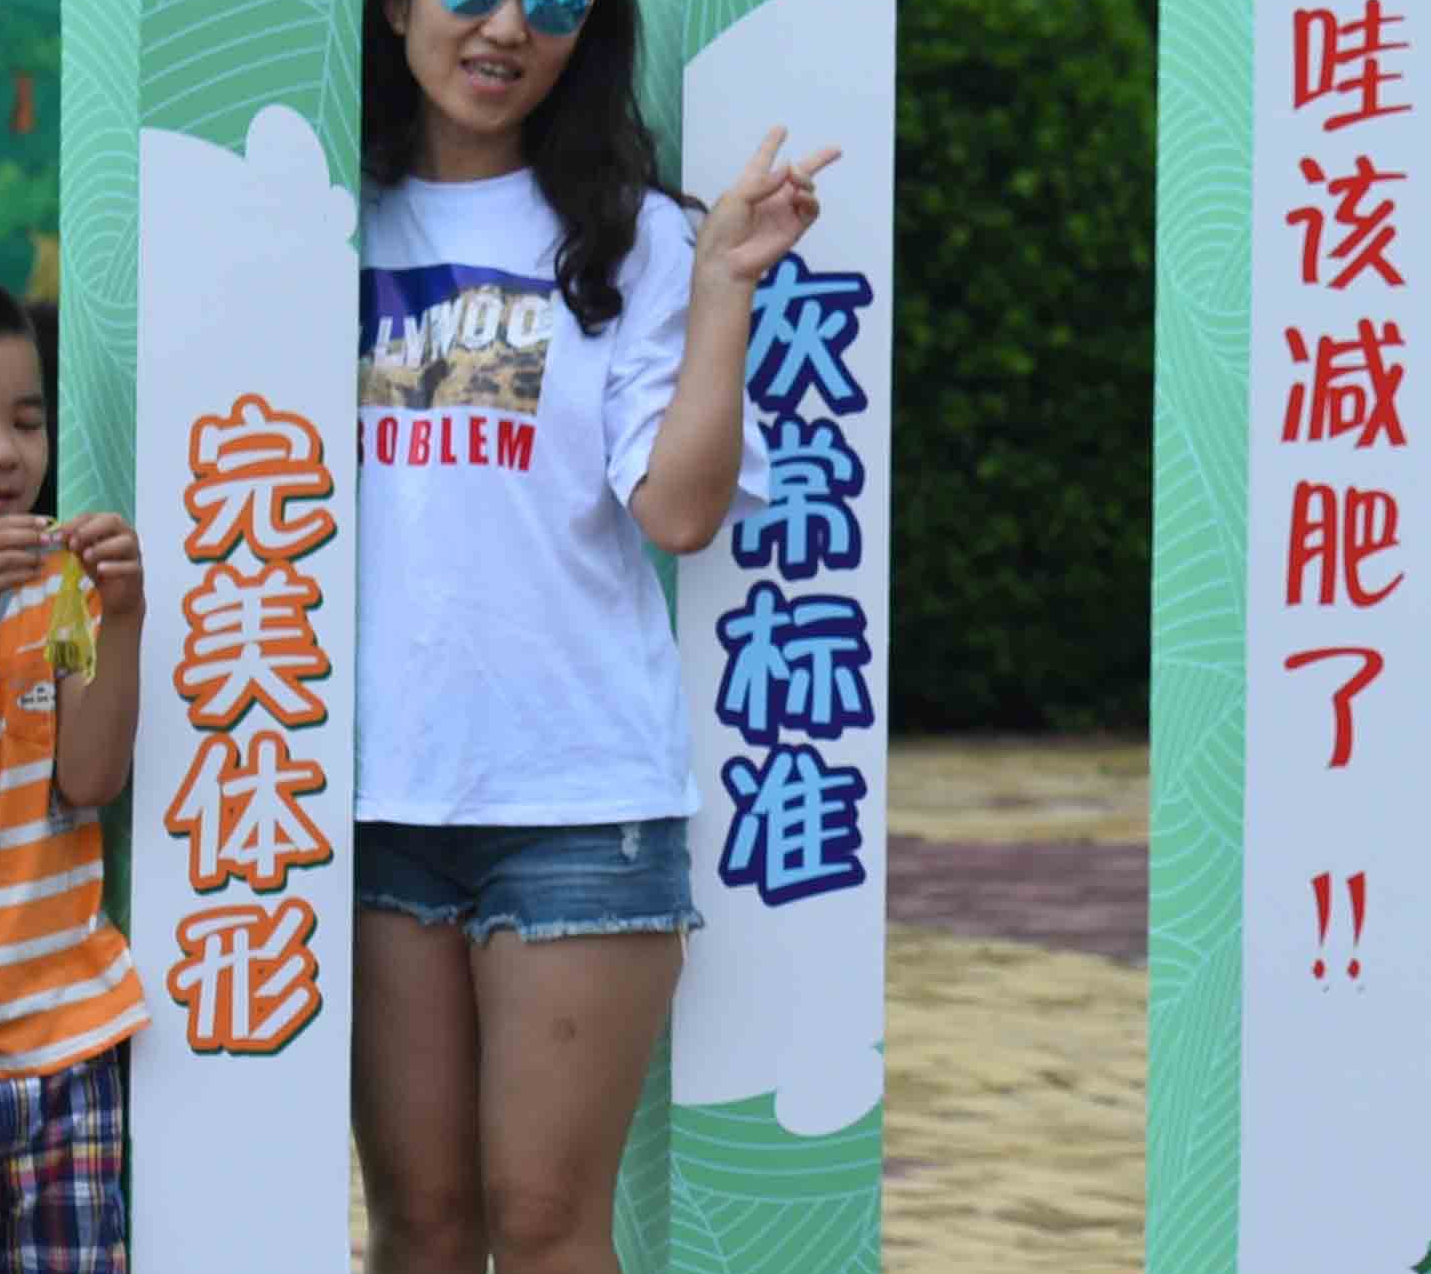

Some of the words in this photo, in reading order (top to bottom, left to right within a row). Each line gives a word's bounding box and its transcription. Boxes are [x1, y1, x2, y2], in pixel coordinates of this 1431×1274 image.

[164, 393, 337, 1055] 完美体形
[716, 251, 874, 907] 灰常标准
